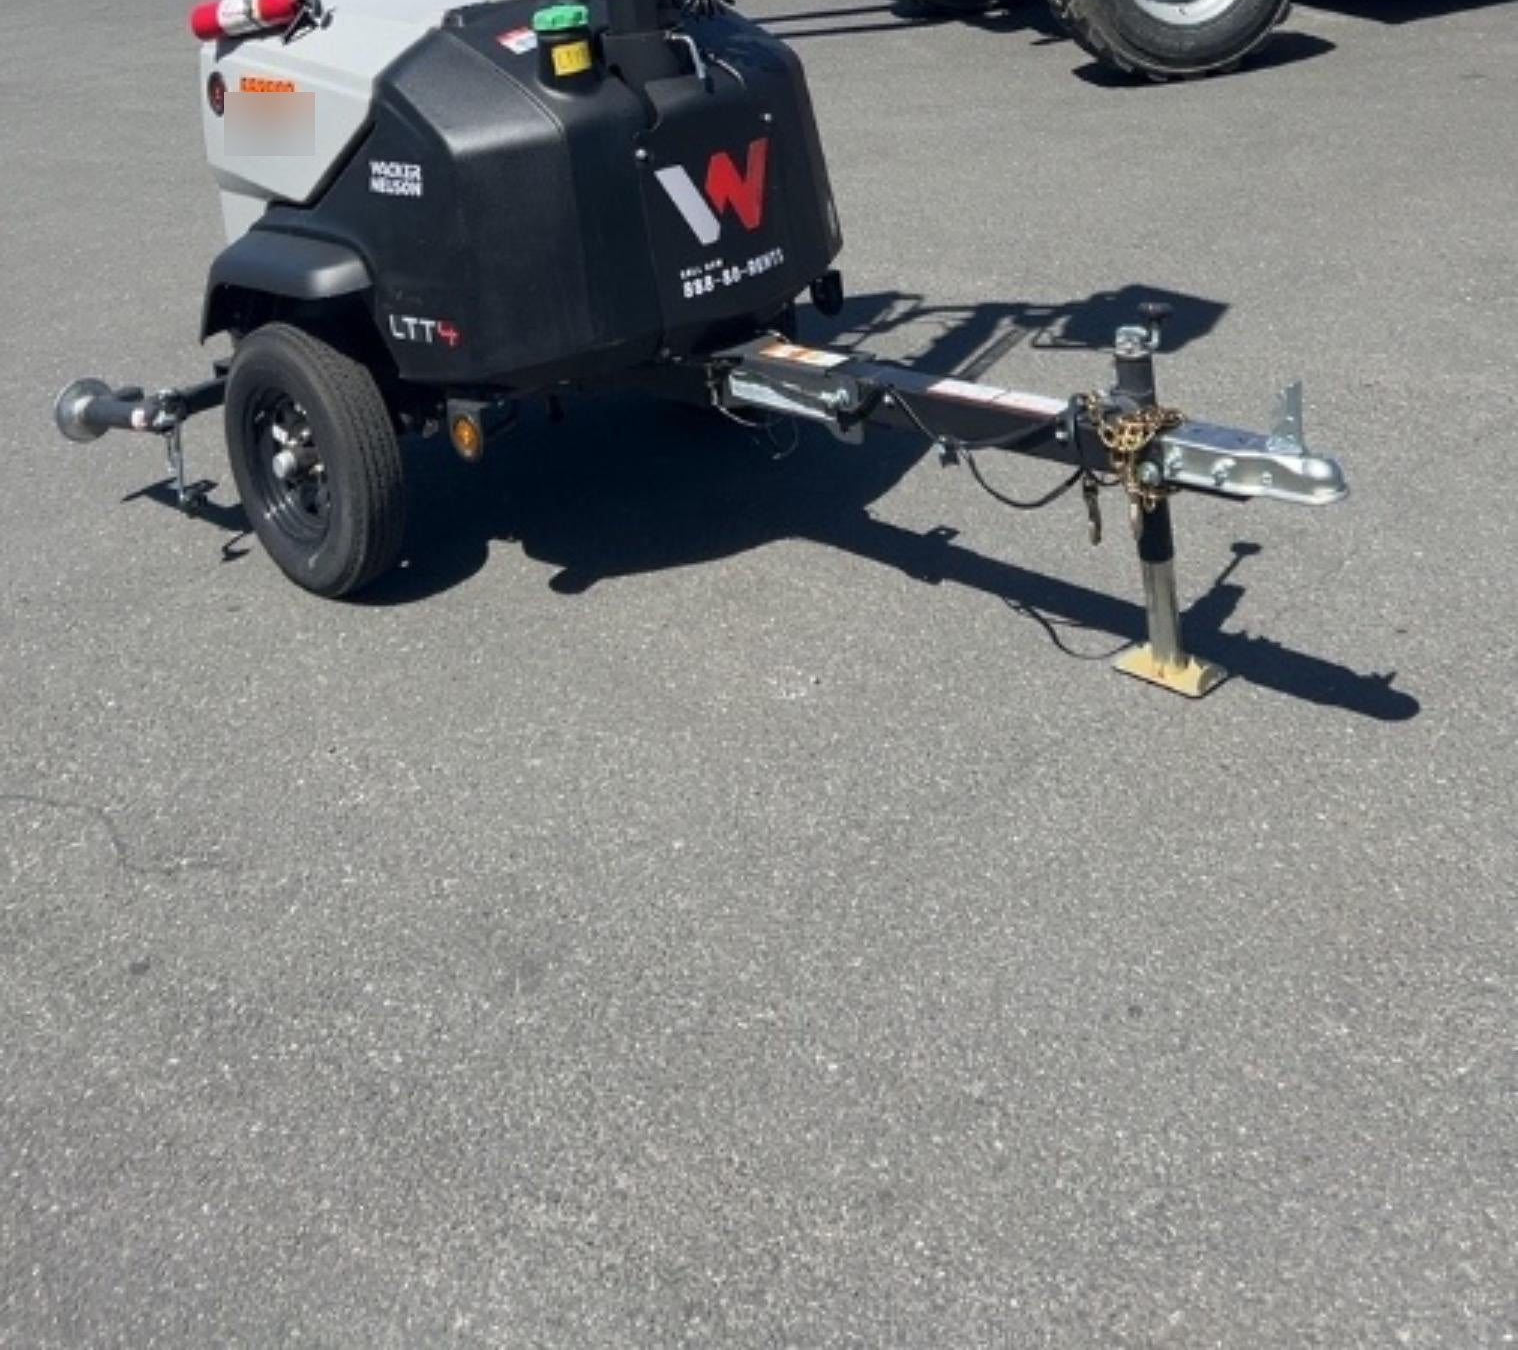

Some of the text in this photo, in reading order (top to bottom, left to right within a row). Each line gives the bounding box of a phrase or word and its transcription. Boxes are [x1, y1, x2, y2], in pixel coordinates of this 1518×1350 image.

[369, 160, 421, 181] WACKER
[370, 177, 423, 197] NEUSON
[388, 313, 459, 346] LTT4
